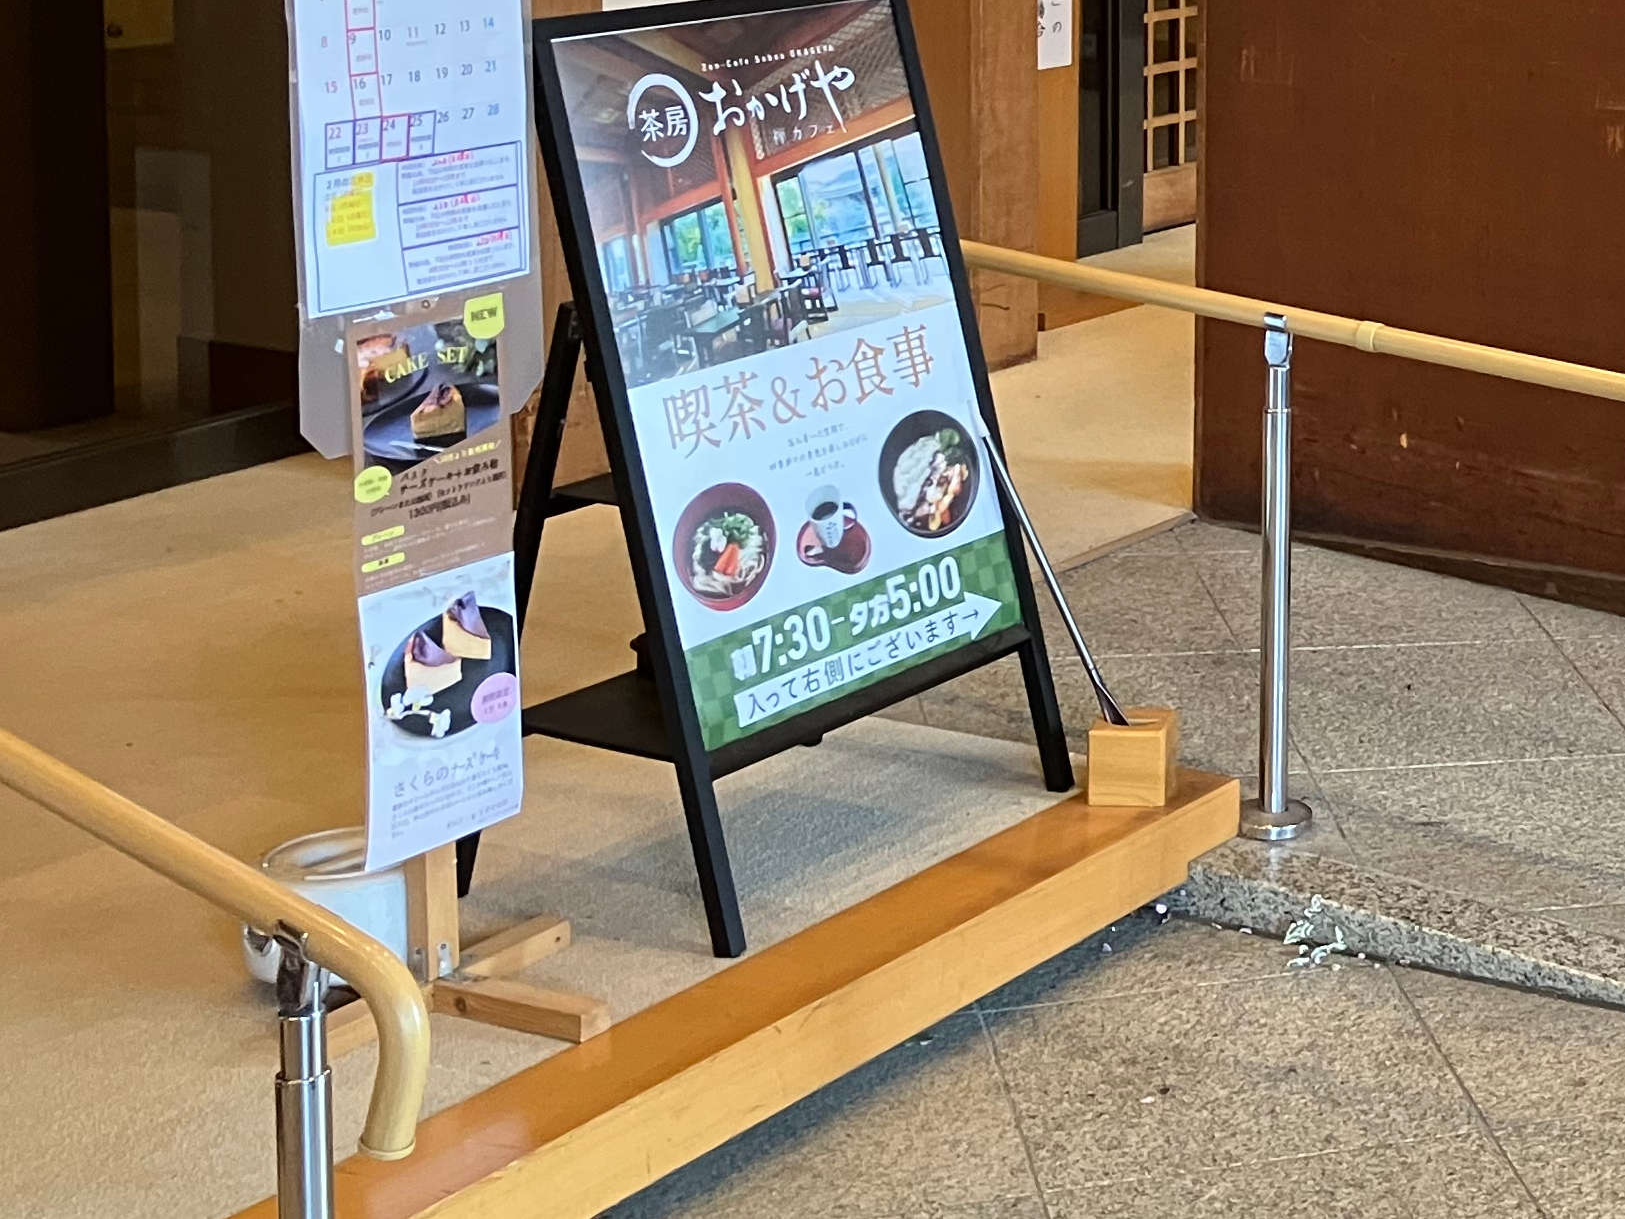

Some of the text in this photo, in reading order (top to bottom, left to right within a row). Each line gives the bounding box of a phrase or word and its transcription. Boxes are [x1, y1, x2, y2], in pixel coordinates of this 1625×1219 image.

[321, 17, 495, 48] 8 9 10 11 12 13 14
[325, 60, 496, 94] 15 16 17 18 19 20 21
[701, 58, 749, 73] Zen-Cafe
[699, 60, 855, 136] おかげや
[328, 103, 499, 140] 22 23 24 25 26 27 28
[638, 105, 688, 143] 茶房
[471, 306, 498, 322] NEW
[384, 346, 467, 383] CAKE SET
[662, 323, 934, 459] 喫茶&お食事
[393, 746, 500, 798] さくらのチーズケーキ
